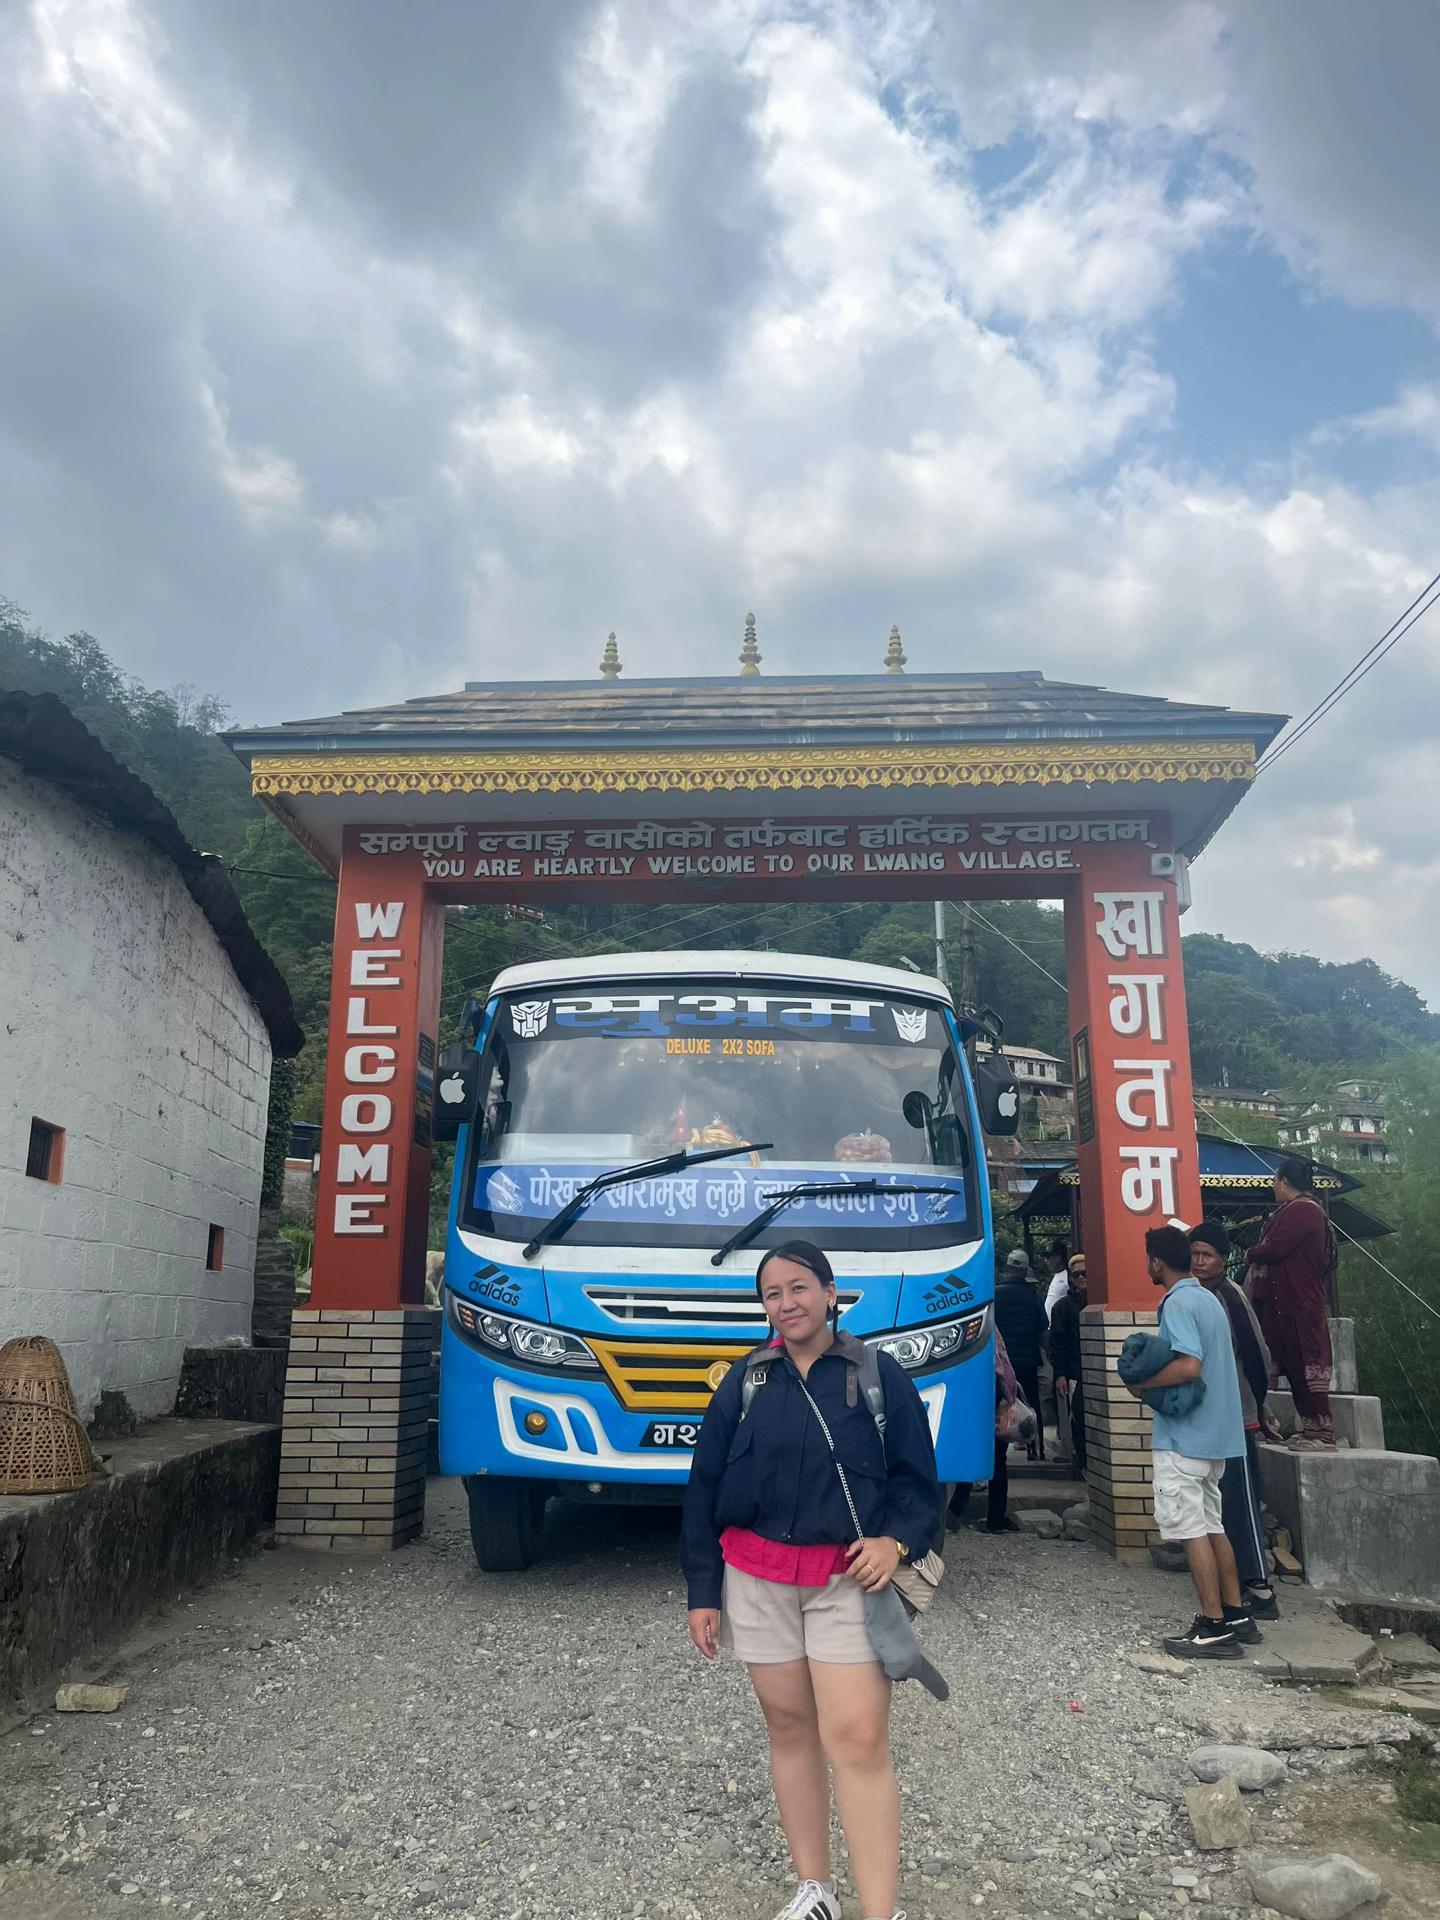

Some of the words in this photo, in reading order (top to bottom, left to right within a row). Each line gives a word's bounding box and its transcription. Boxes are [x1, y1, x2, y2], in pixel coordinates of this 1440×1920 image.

[360, 825, 468, 857] सम्पूर्ण
[584, 821, 715, 849] वासीको
[724, 819, 848, 848] तर्फबाट
[858, 816, 969, 848] हार्दिक
[422, 859, 464, 877] YOU
[474, 859, 521, 876] ARE
[534, 857, 635, 876] HEARTLY
[648, 855, 755, 875] WELCOME
[764, 855, 794, 872] TO
[807, 853, 854, 872] OUR
[864, 852, 945, 871] LWANG
[958, 850, 1080, 870] VILLAGE.
[666, 1038, 711, 1055] DELUXE
[722, 1039, 744, 1055] 2X2
[746, 1040, 776, 1056] SOFA
[334, 902, 404, 1234] WELCOME
[530, 1168, 598, 1208] पोख
[468, 1279, 520, 1308] adidas
[925, 1289, 975, 1314] adidas
[653, 1424, 701, 1445] ग२
